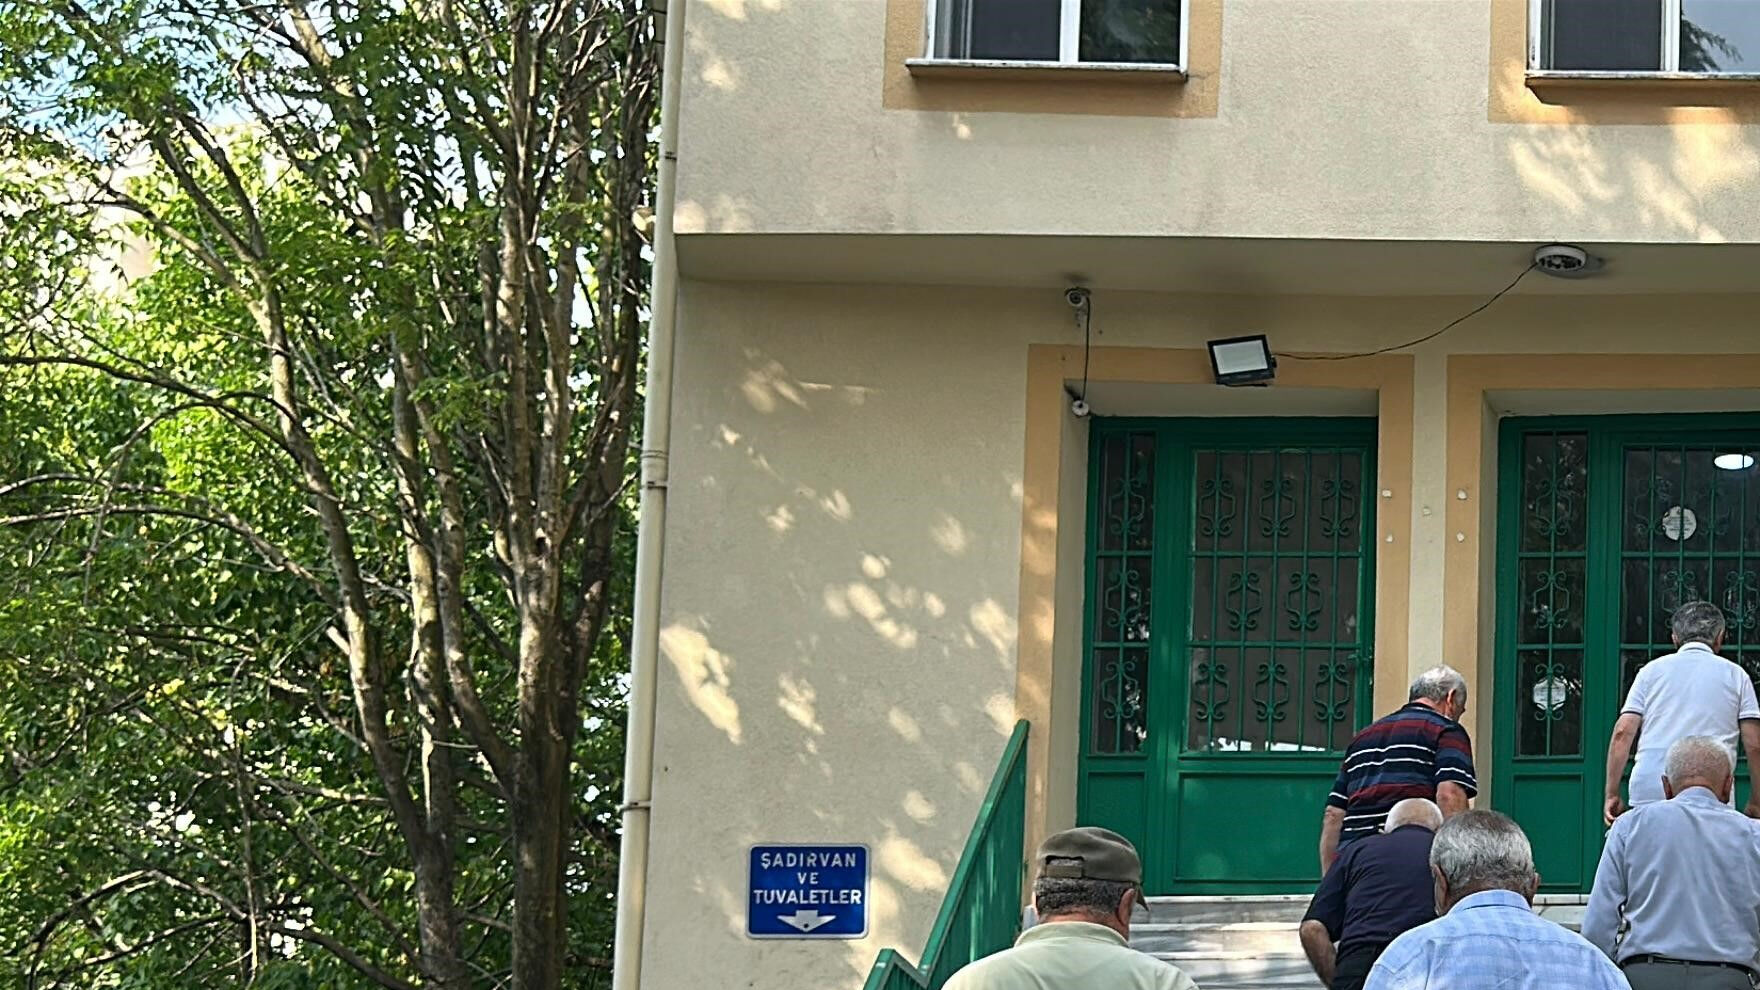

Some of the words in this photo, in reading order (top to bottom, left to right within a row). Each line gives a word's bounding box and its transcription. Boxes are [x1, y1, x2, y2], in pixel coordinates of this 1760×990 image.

[761, 853, 856, 869] ŞADIRVAN
[797, 872, 819, 884] VE
[753, 889, 862, 904] TUVALETLER
